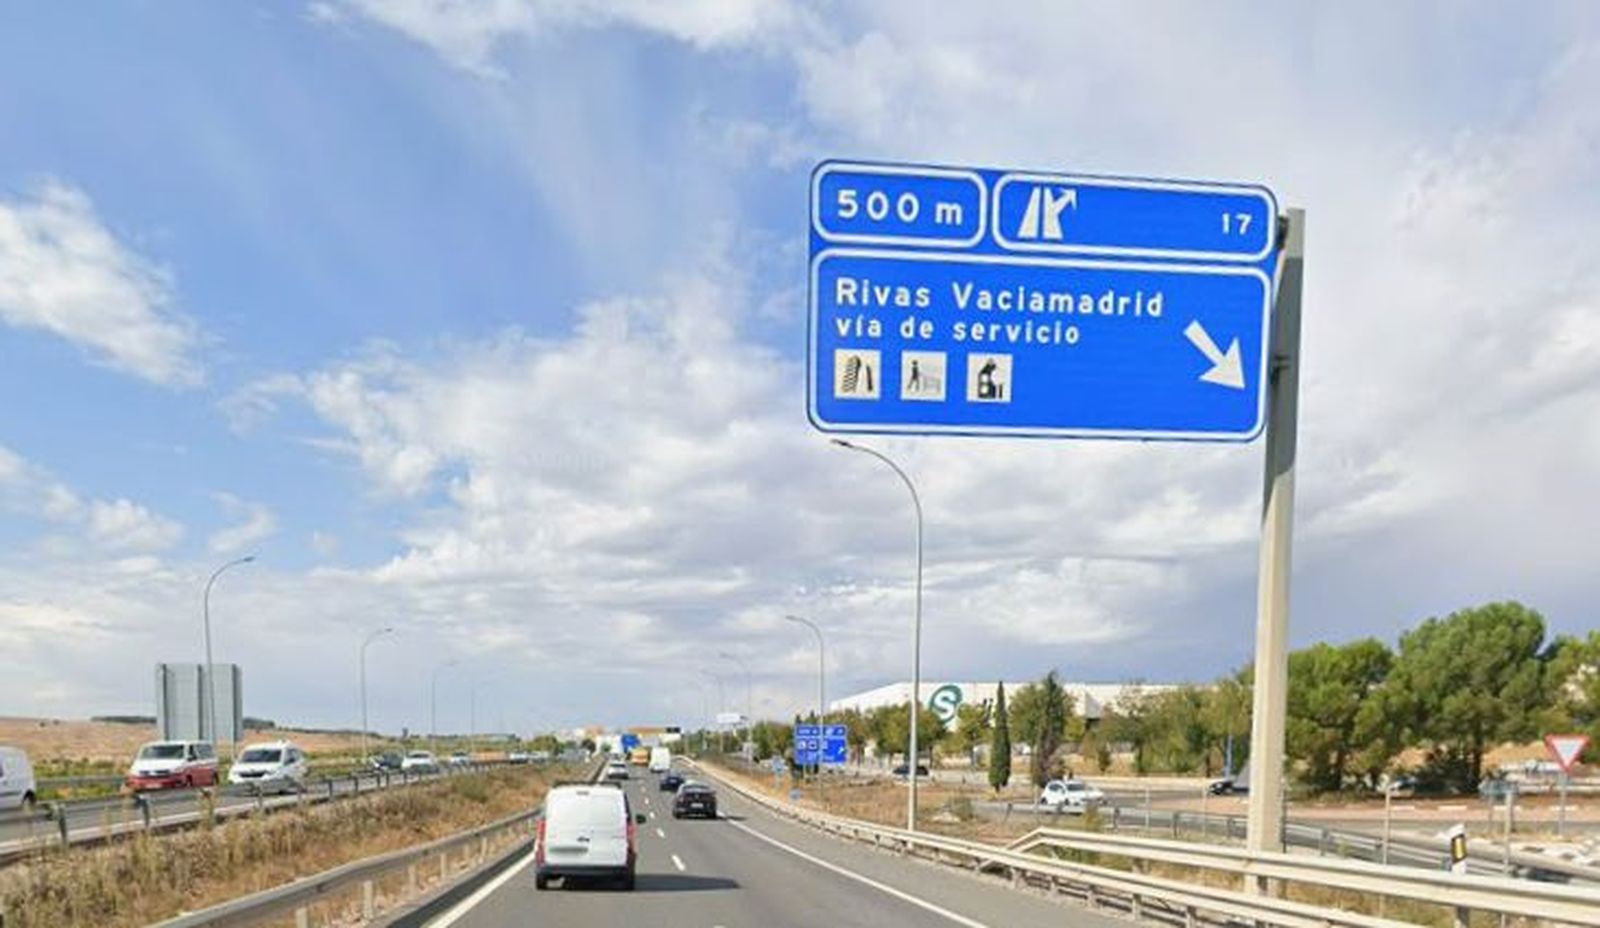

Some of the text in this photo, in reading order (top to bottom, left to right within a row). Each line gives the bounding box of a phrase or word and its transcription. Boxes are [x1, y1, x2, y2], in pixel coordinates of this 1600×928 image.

[837, 189, 962, 225] 500 m
[1222, 213, 1252, 235] 17
[836, 277, 1163, 317] Rivas Vaciamadrid
[836, 315, 1079, 344] vía de servicio
